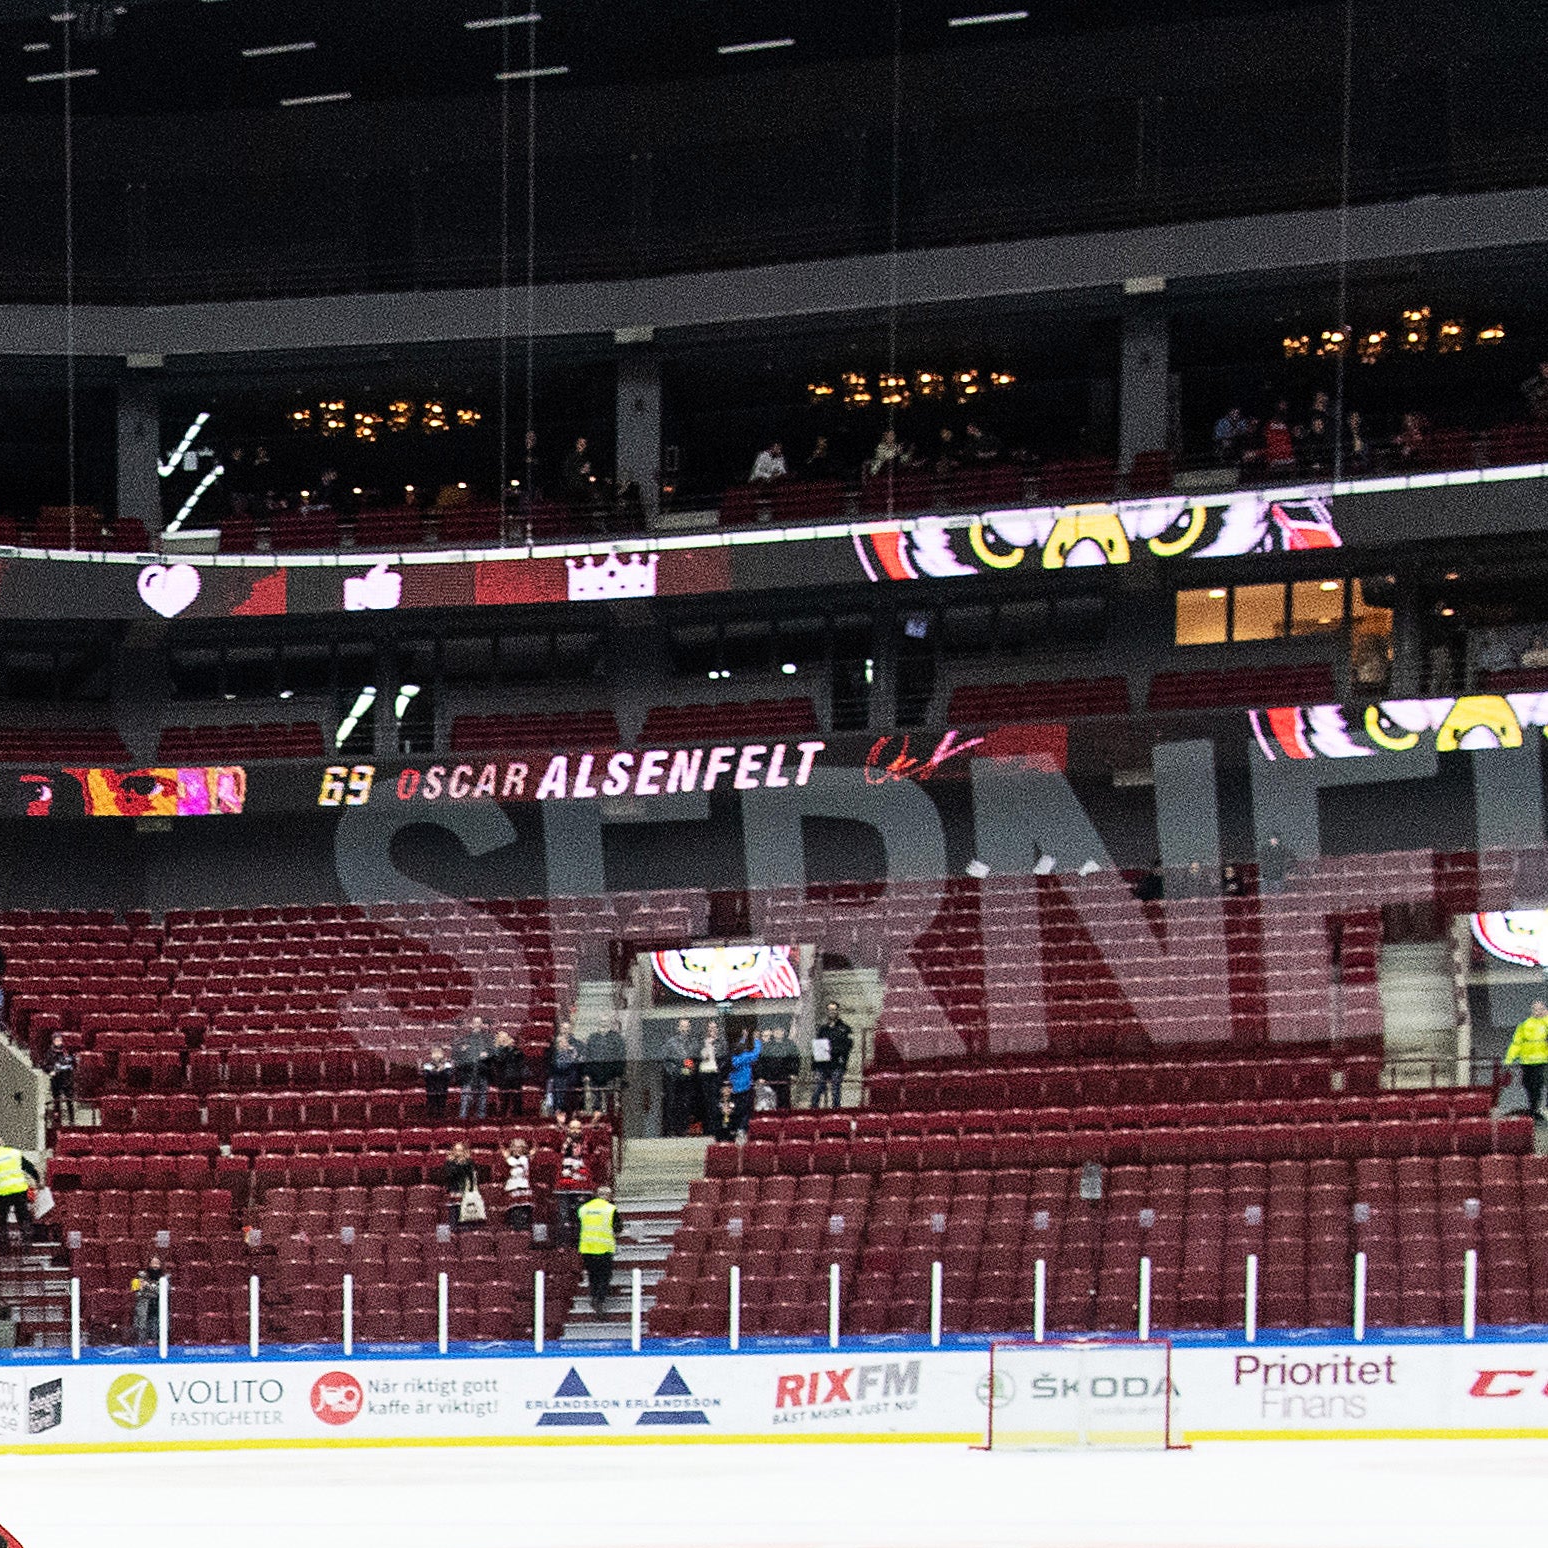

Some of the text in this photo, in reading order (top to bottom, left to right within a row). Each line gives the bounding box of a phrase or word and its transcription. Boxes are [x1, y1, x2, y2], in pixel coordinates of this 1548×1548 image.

[318, 765, 375, 806] 69
[396, 762, 530, 801] OSCAR
[536, 741, 826, 799] ALSENFELT
[1234, 1354, 1398, 1386] Prioritet
[168, 1379, 284, 1405] VOLITO
[367, 1378, 499, 1400] När riktigt gott
[1031, 1371, 1181, 1399] ŠKODA
[367, 1397, 499, 1419] kaffe är viktigt!
[1261, 1389, 1367, 1419] Finans
[170, 1410, 284, 1427] FASTIGHETER
